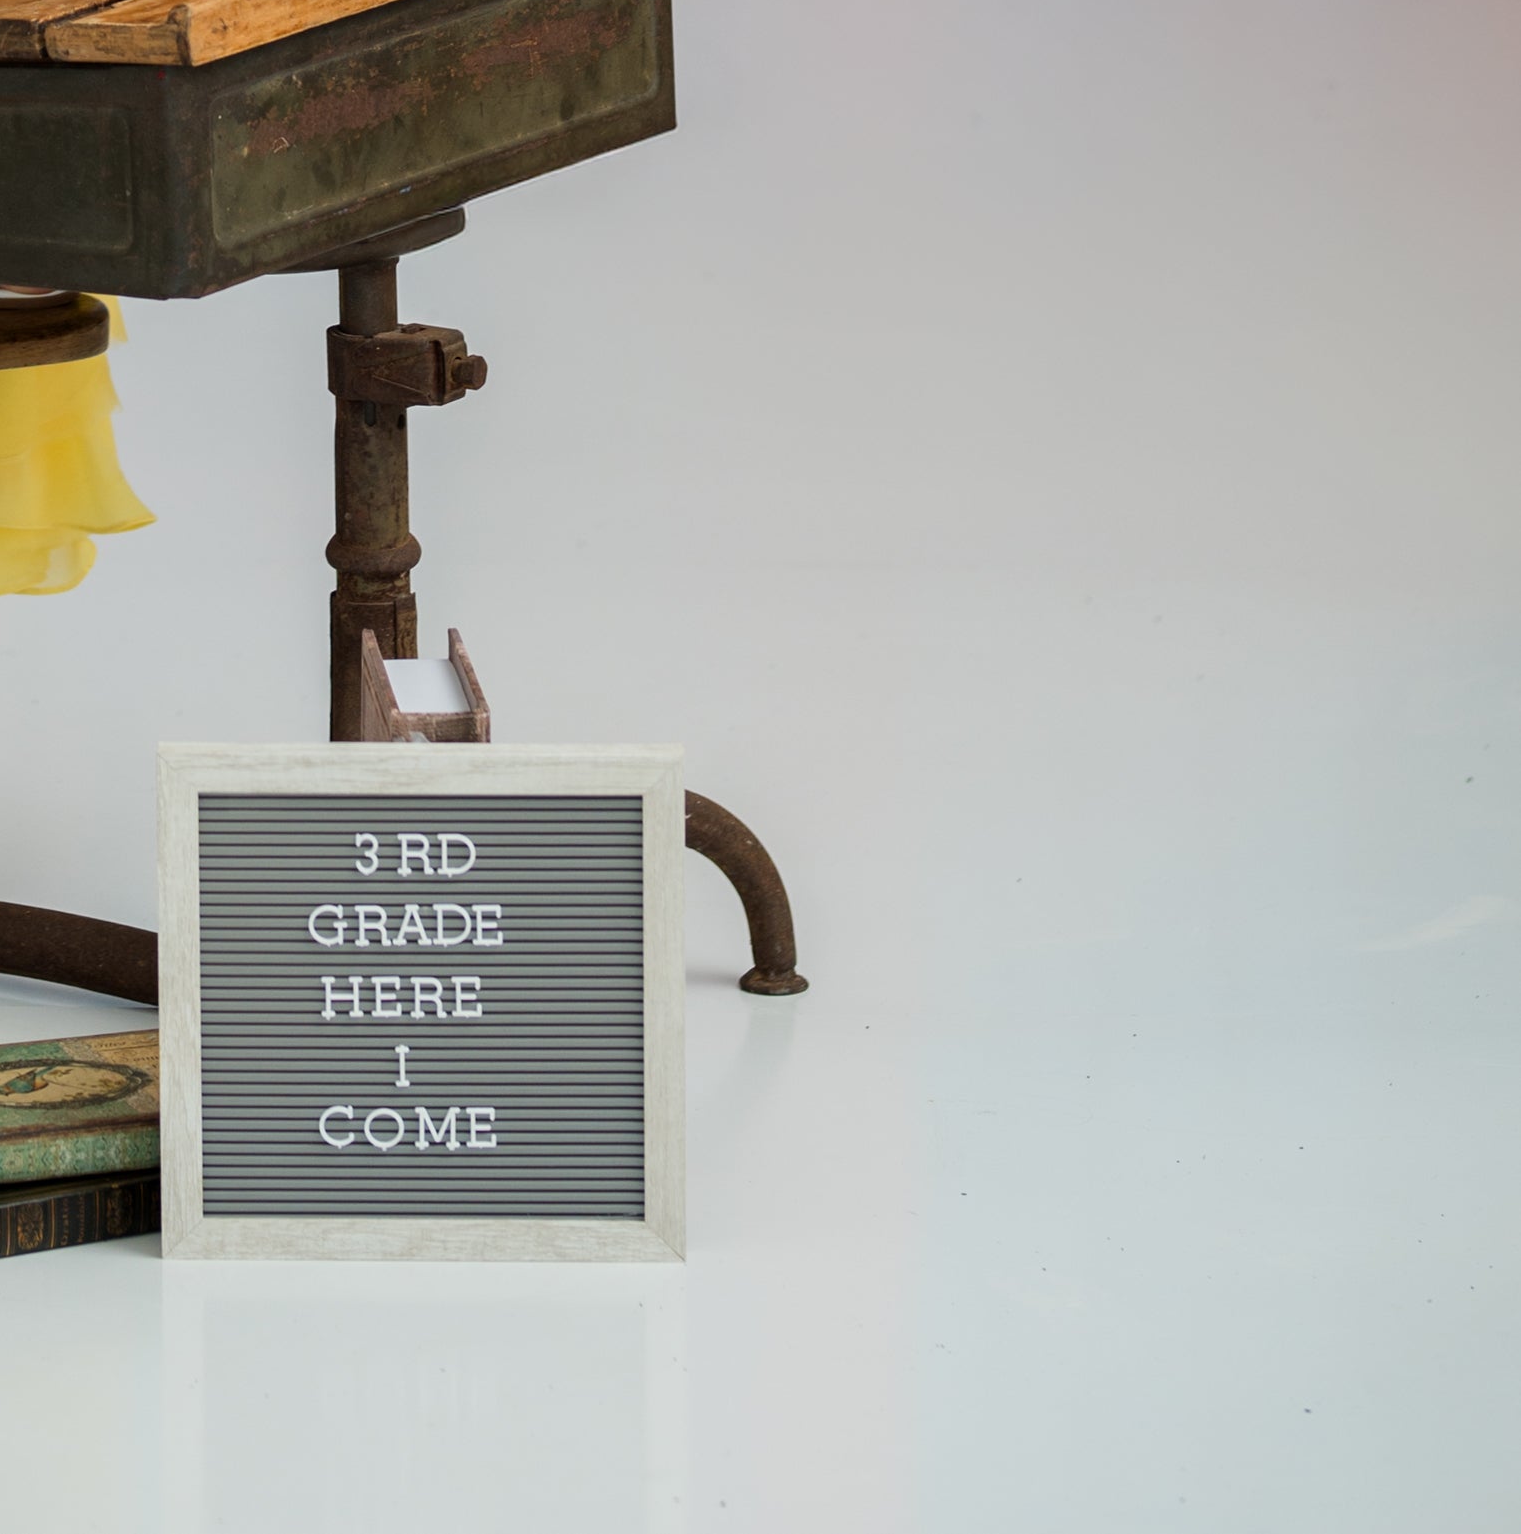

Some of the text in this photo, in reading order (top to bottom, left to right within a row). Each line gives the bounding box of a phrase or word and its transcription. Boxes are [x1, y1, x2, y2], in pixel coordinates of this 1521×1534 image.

[308, 904, 503, 947] GRADE
[321, 976, 483, 1020] HERE
[395, 1044, 410, 1087] I
[319, 1105, 497, 1151] COME
